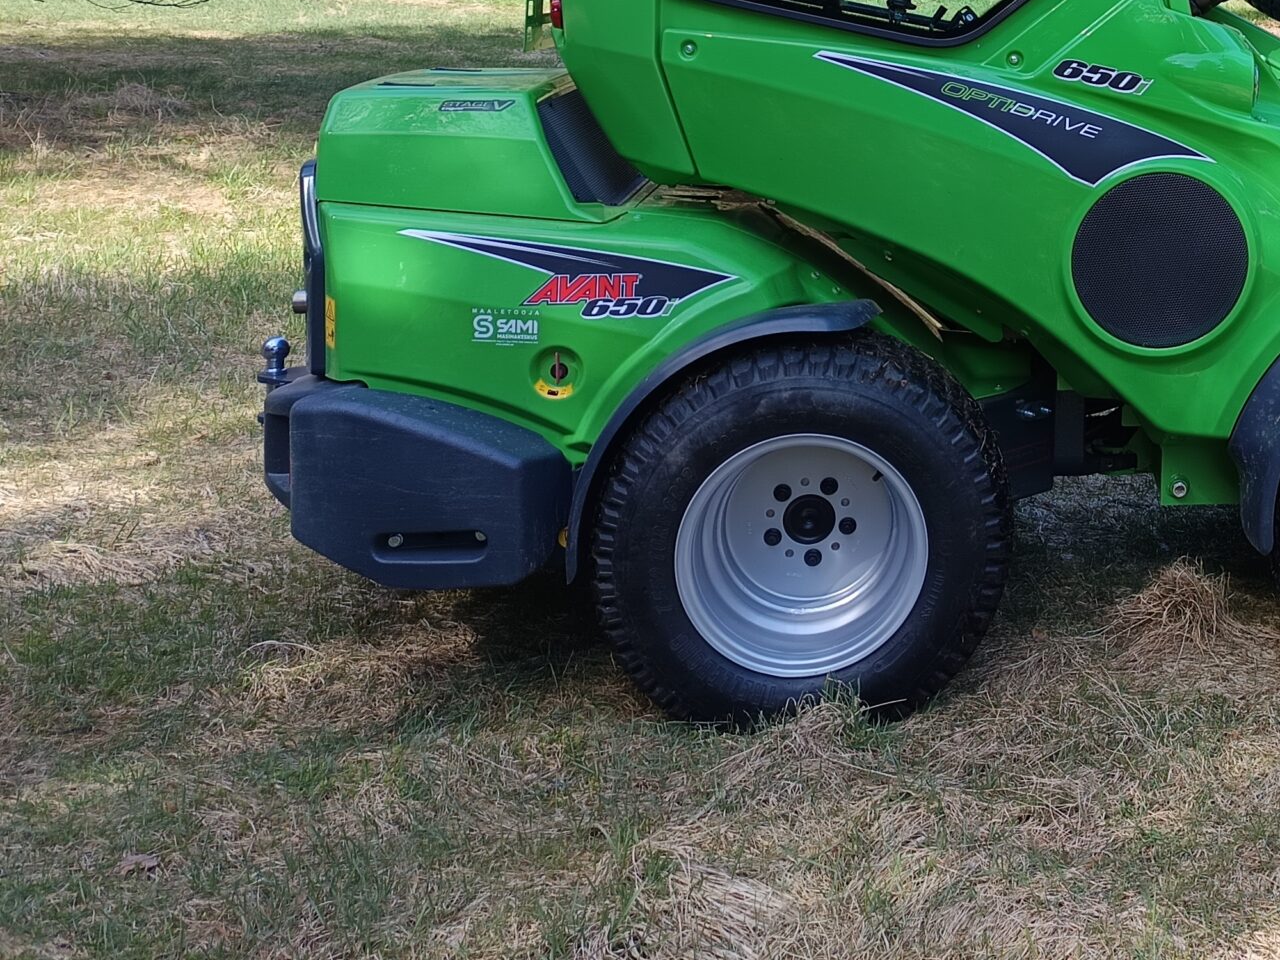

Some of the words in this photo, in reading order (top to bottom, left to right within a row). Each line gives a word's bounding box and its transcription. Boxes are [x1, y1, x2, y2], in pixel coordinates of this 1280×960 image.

[1052, 59, 1154, 96] 650i
[941, 81, 1104, 139] OPTIDRIVE
[521, 273, 640, 306] AVANT
[471, 307, 540, 316] MAALETOOJA
[580, 296, 680, 319] 650i
[496, 318, 538, 334] SAMI
